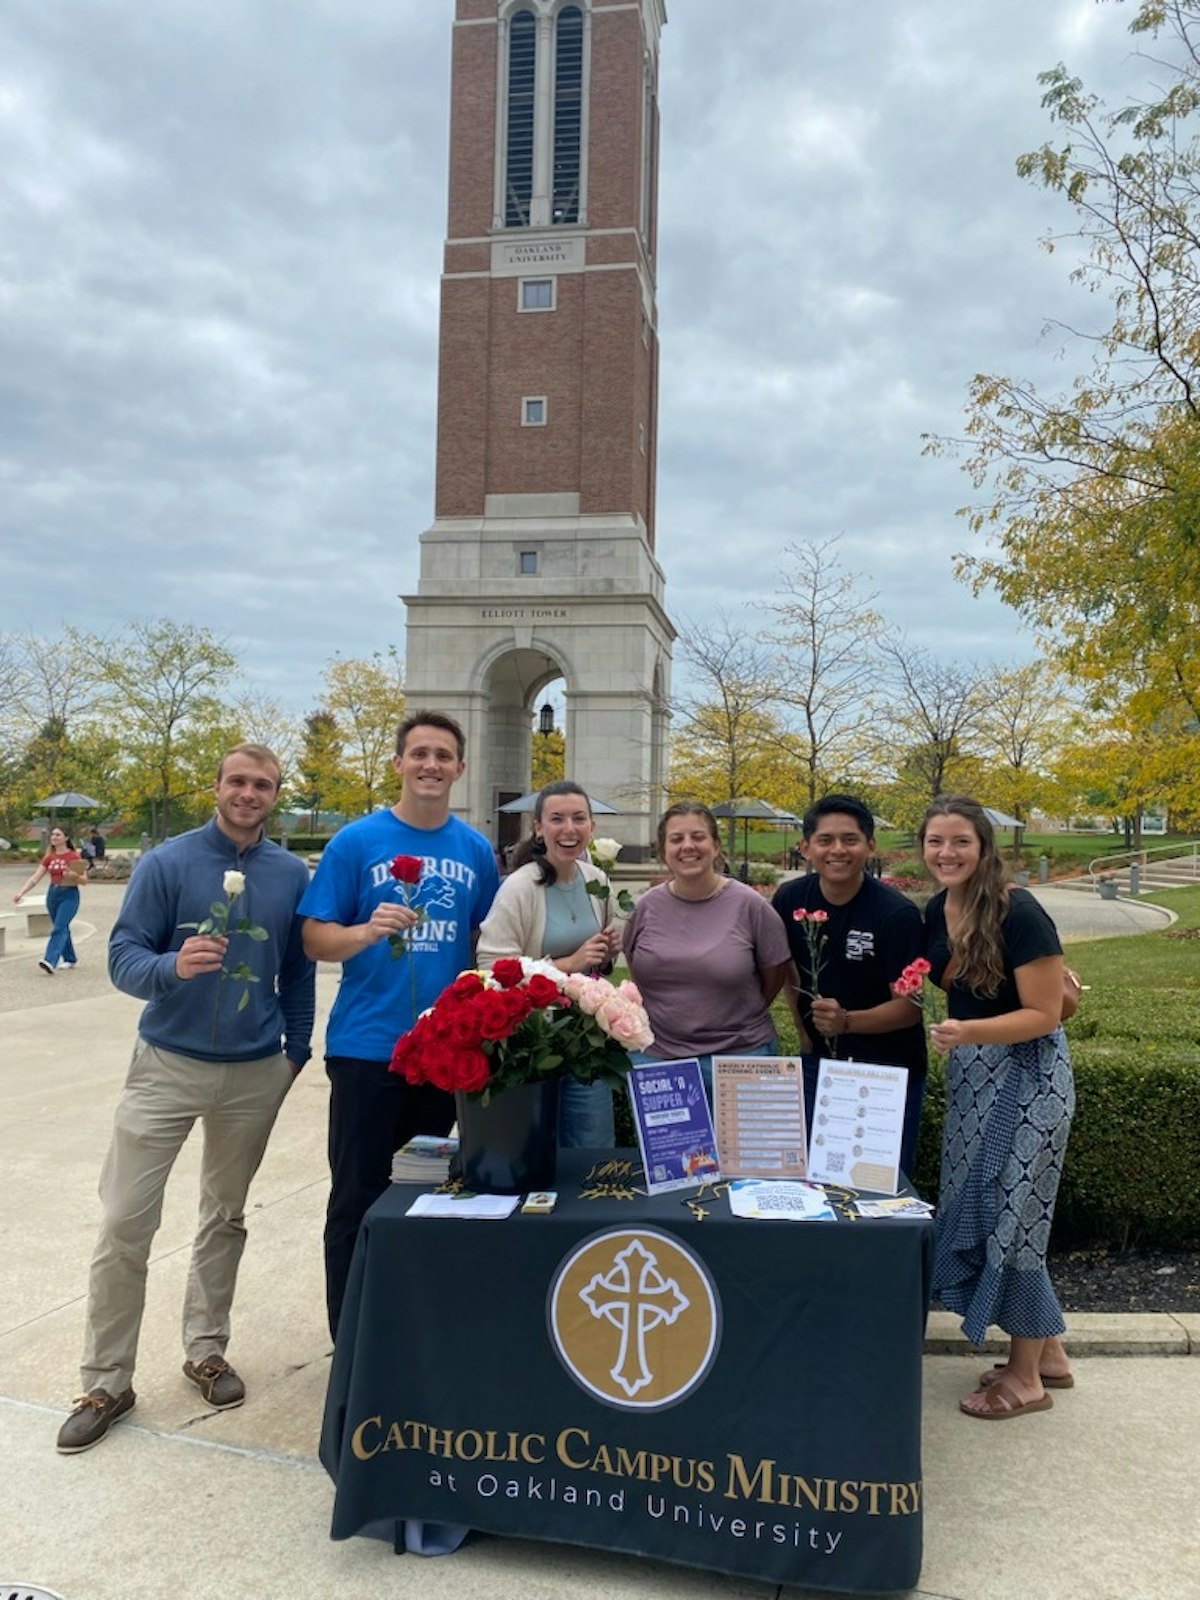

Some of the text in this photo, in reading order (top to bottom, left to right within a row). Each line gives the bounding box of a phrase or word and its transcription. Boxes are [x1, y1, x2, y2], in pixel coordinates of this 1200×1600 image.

[515, 245, 562, 254] OAKLAND
[509, 254, 566, 263] UNIVERSITY
[482, 609, 567, 618] ELLIOTT TOWER
[371, 855, 476, 890] DROIT
[639, 1079, 673, 1095] SOCIAL
[641, 1092, 683, 1112] SUPPER
[429, 1469, 843, 1555] at Oakland University
